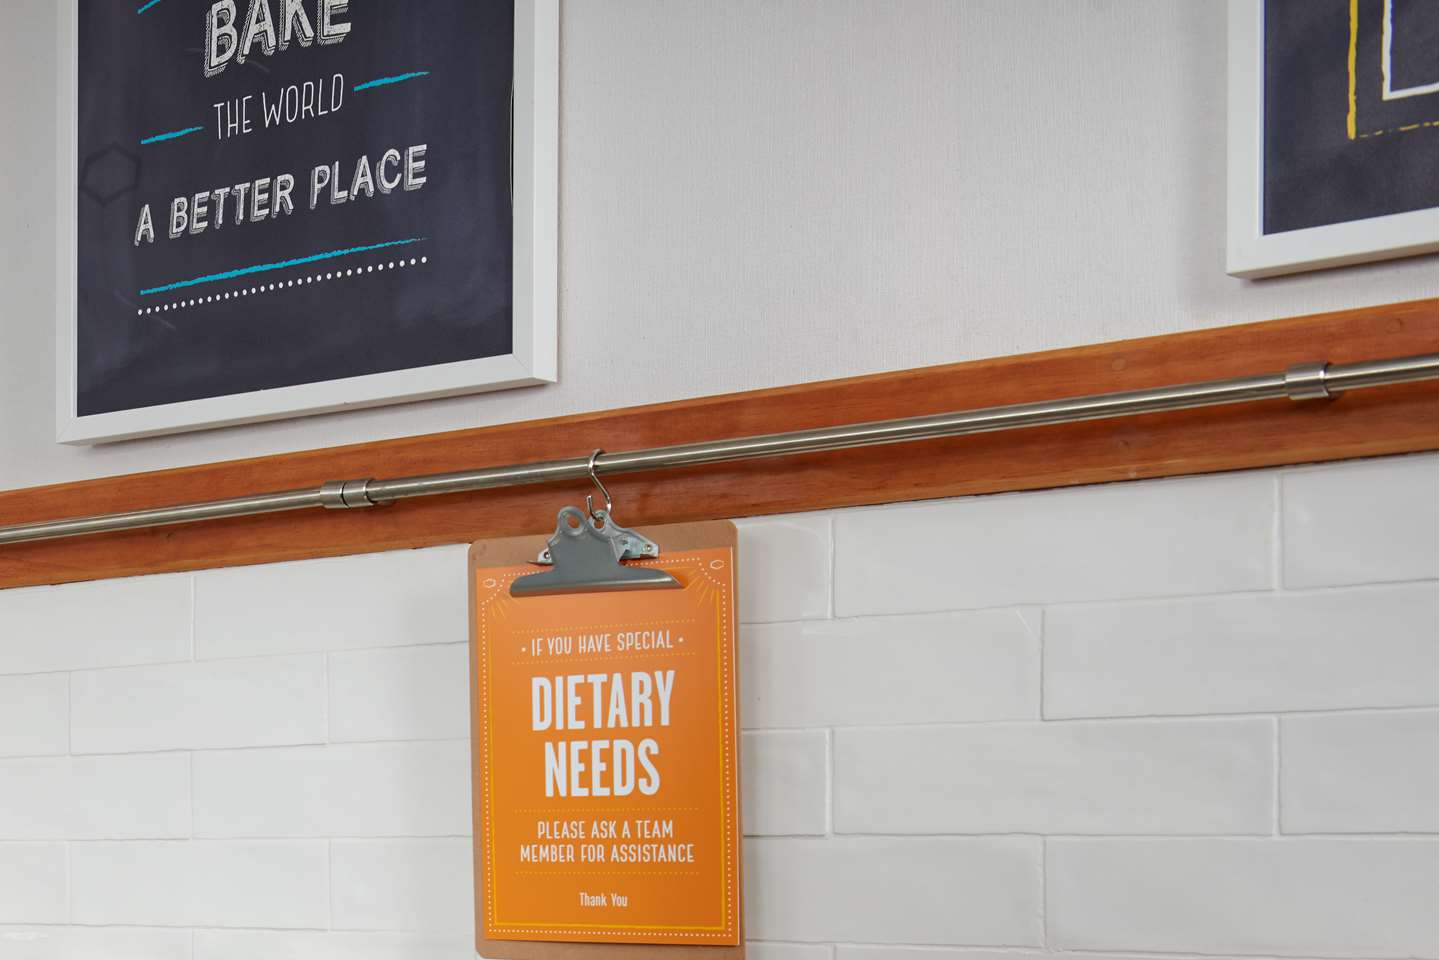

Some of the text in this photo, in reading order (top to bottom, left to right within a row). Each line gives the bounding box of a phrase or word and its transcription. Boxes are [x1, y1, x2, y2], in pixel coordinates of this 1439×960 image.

[204, 0, 351, 78] BAKE
[213, 73, 344, 140] THE WORLD
[134, 144, 428, 246] A BETTER PLACE
[531, 630, 674, 657] IF YOU HAVE SPECIAL
[531, 669, 676, 732] DIETARY
[544, 738, 661, 798] NEEDS
[520, 843, 696, 863] MEMBER FOR ASSISTANCE
[537, 820, 674, 839] PLEASE ASK A TEAM
[579, 891, 628, 908] Thank You
